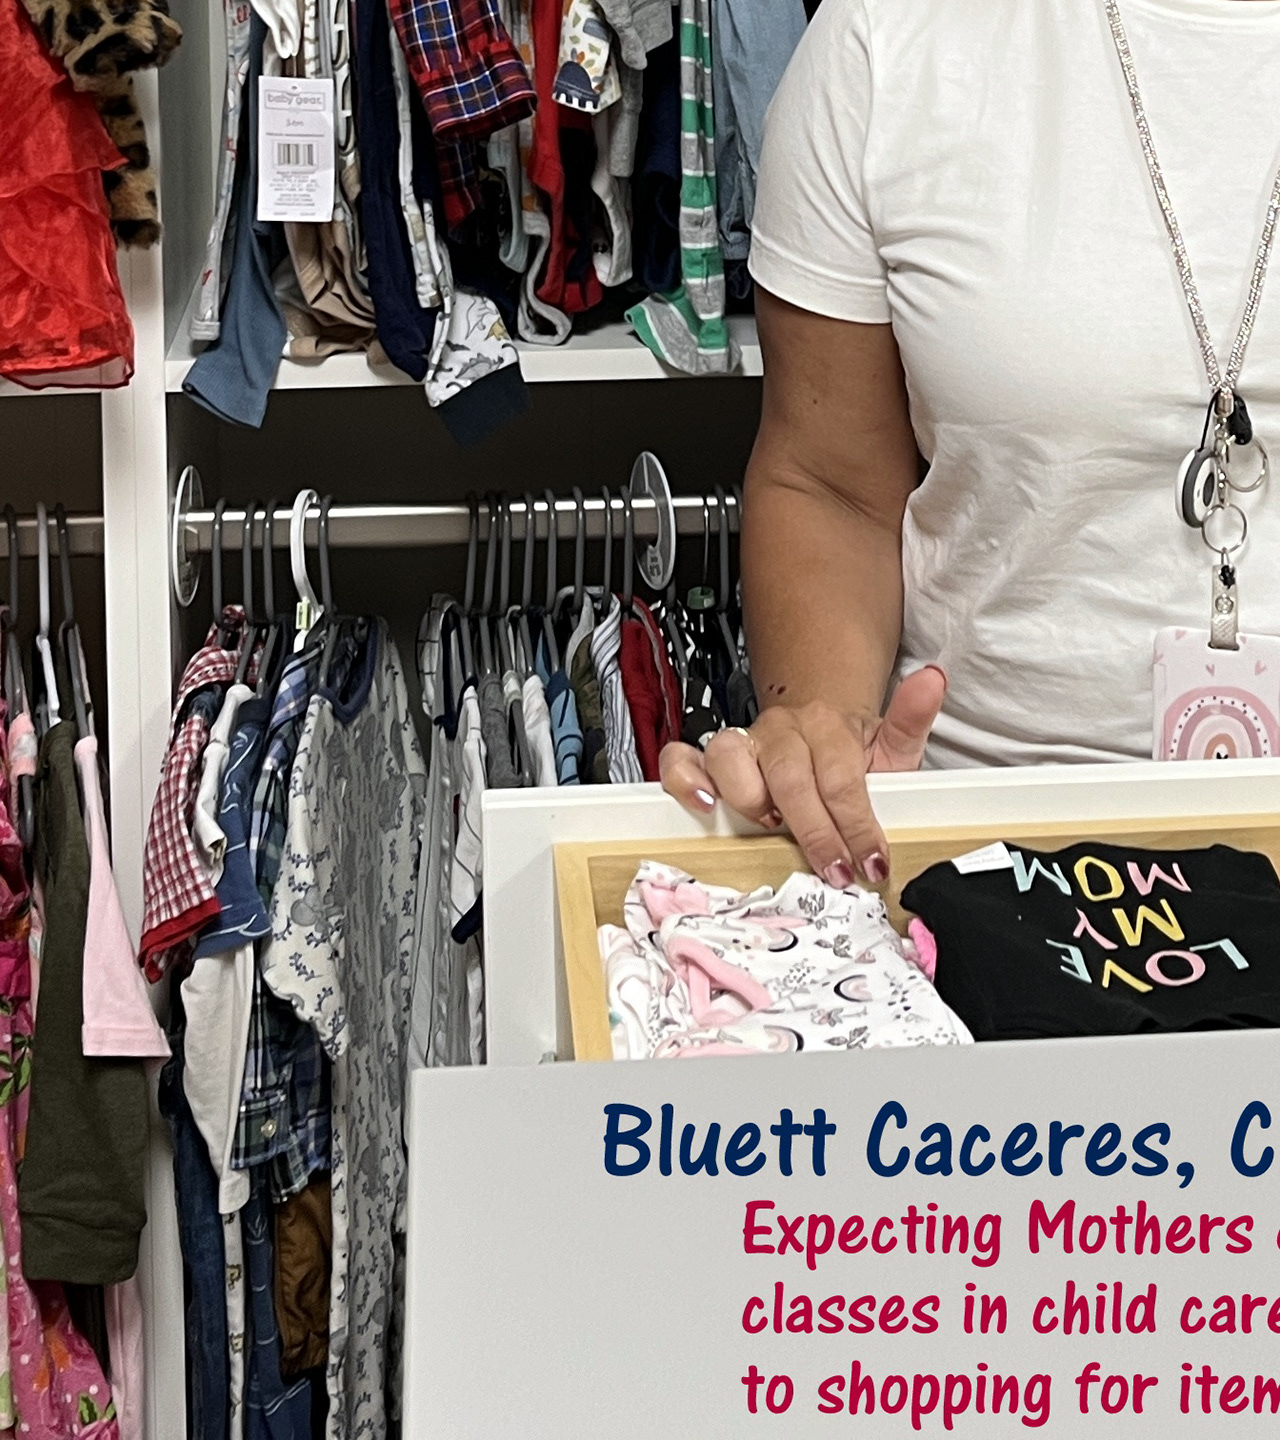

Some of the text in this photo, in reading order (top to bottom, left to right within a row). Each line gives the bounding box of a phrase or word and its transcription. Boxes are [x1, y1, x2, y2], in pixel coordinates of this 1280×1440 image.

[1010, 850, 1192, 901] MOM
[1072, 898, 1186, 950] MY
[1045, 937, 1251, 993] LOVE
